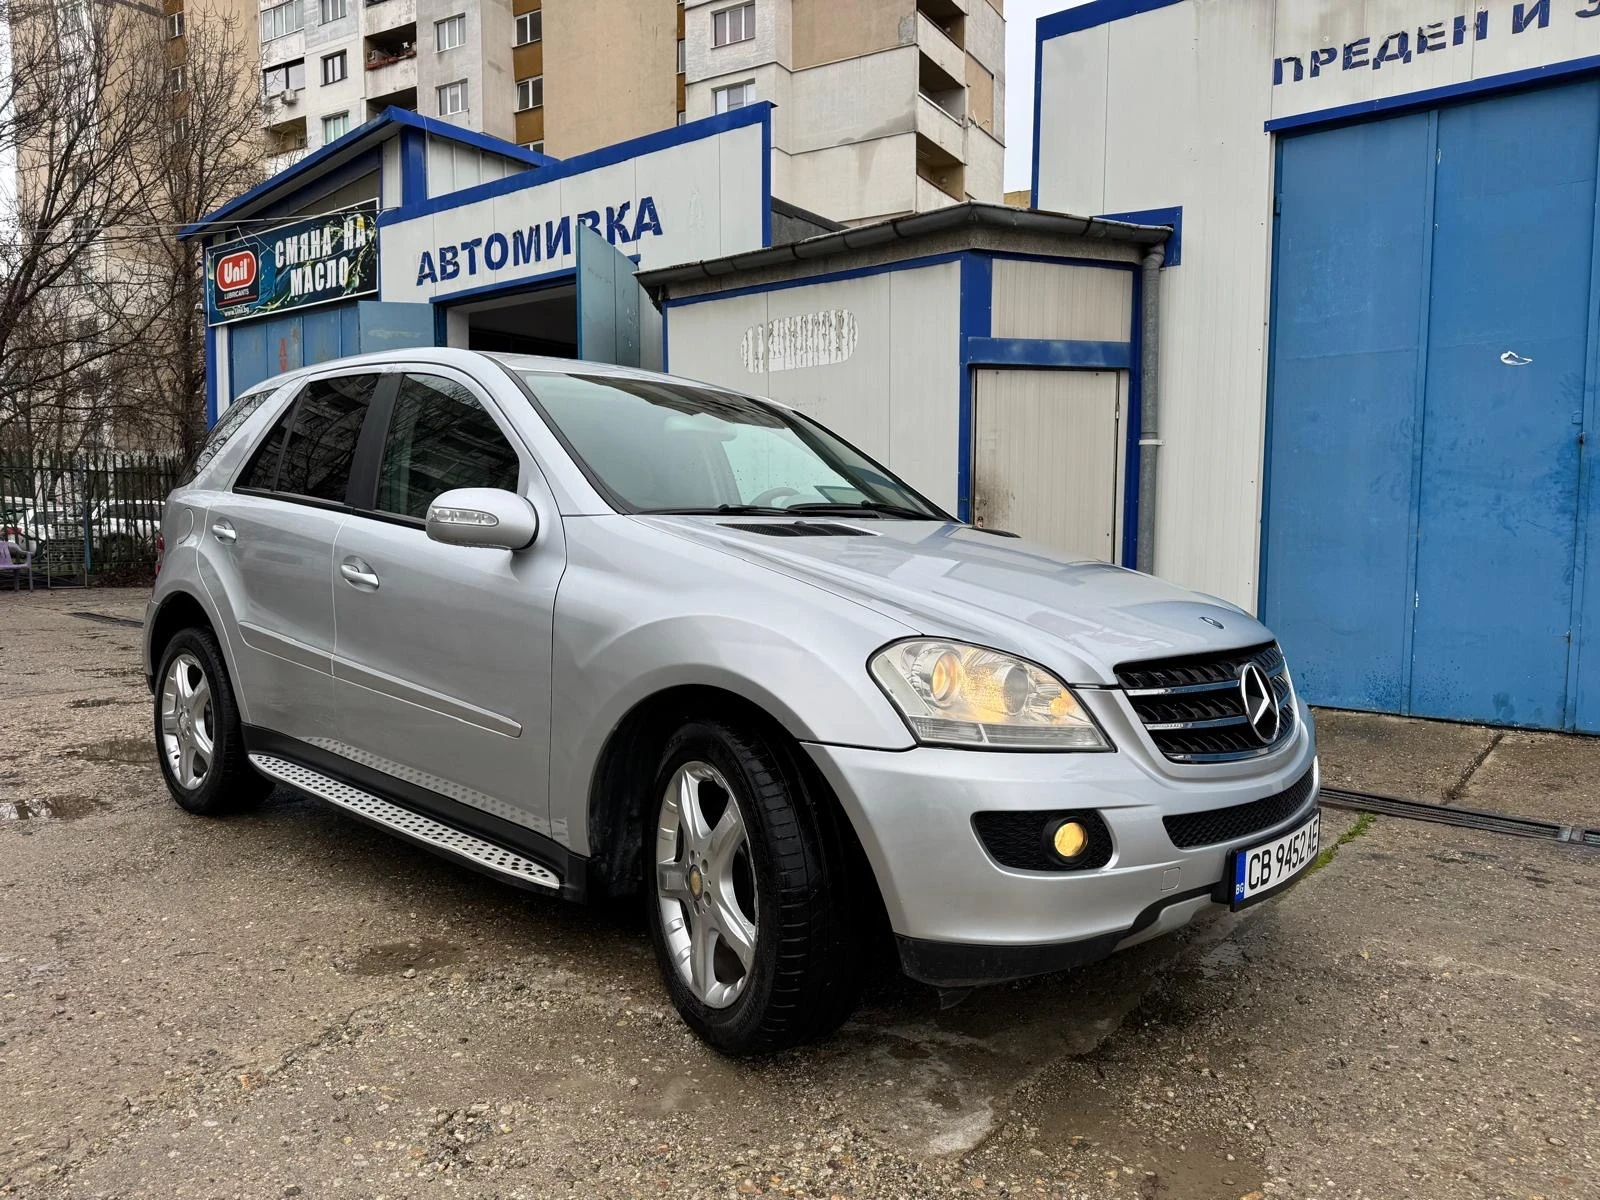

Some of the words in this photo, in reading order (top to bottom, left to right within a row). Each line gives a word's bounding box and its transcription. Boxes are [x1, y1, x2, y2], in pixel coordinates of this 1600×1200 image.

[1273, 10, 1488, 85] ПРЕДЕН
[1512, 0, 1550, 34] И
[275, 226, 332, 269] СМЯНА
[343, 218, 366, 251] НА
[224, 259, 247, 283] Unil
[290, 256, 350, 297] МАСЛО
[1248, 849, 1272, 890] CB
[1276, 830, 1306, 878] 9452
[1306, 819, 1318, 858] AE
[1235, 883, 1245, 895] BG
